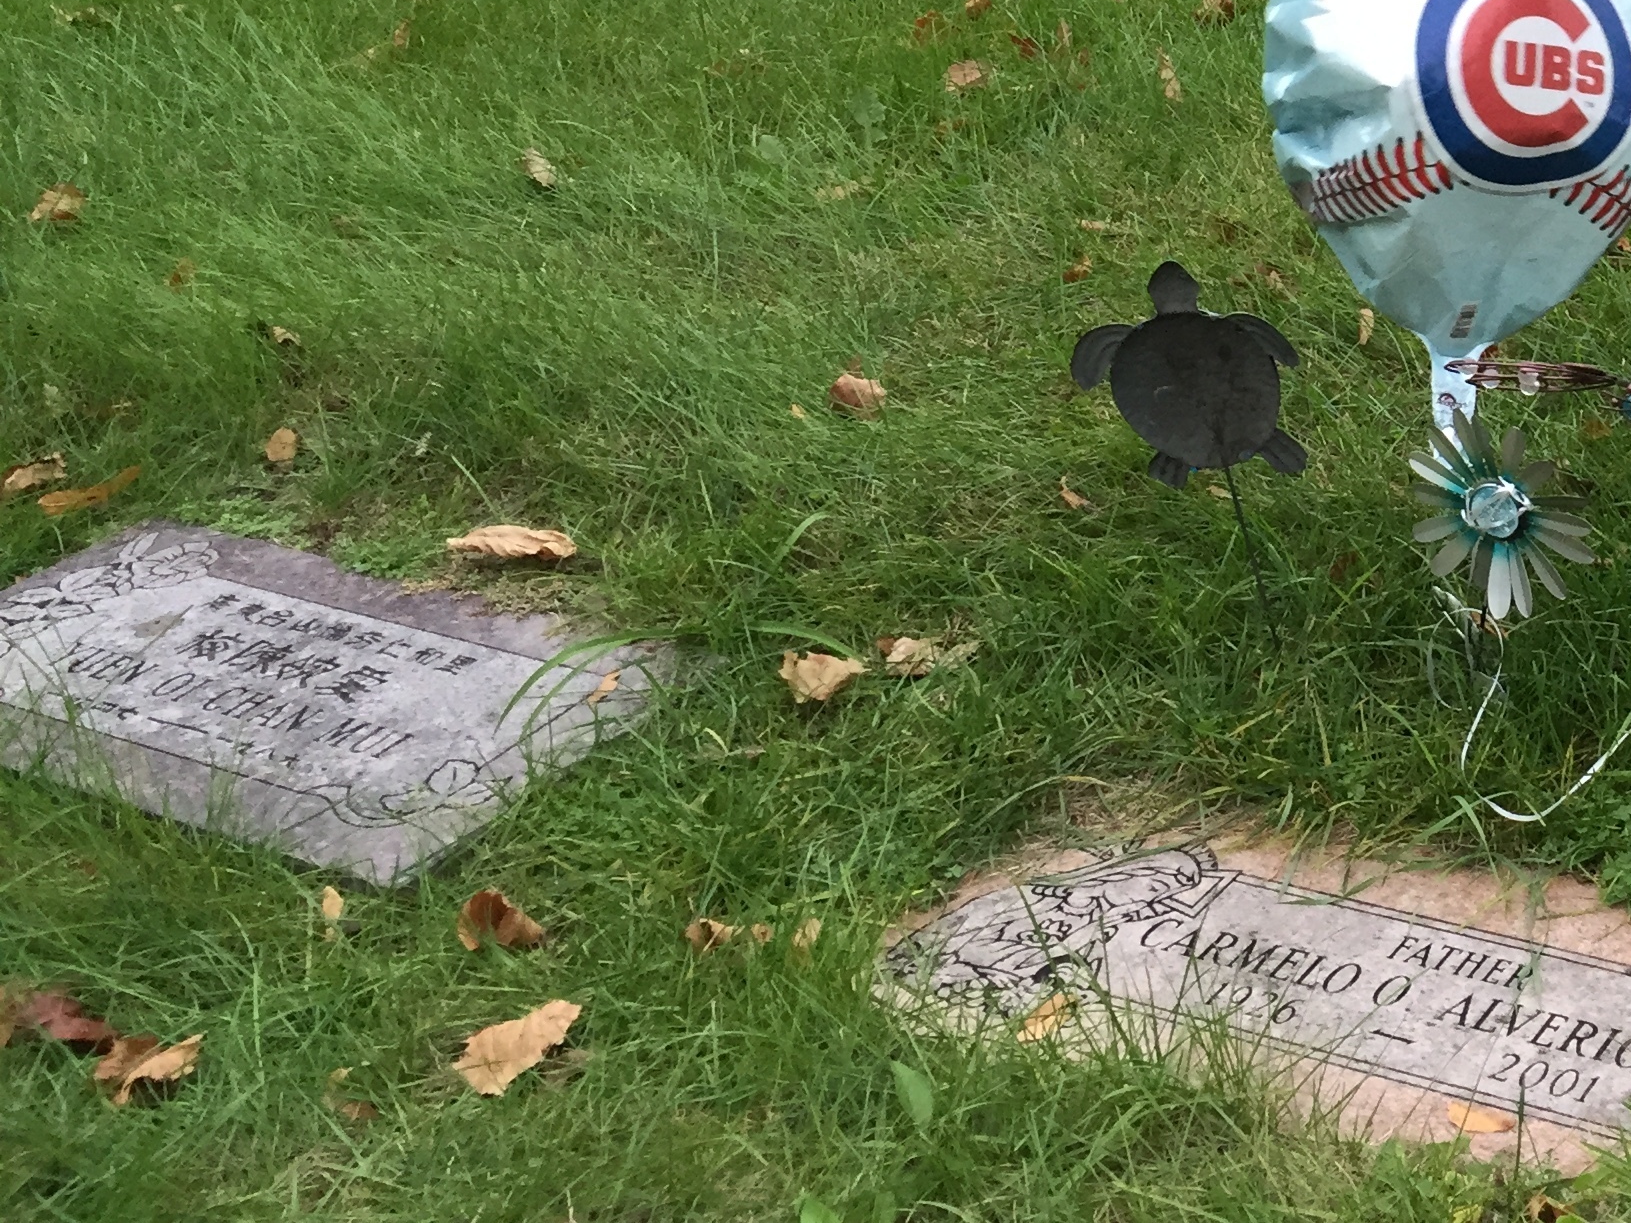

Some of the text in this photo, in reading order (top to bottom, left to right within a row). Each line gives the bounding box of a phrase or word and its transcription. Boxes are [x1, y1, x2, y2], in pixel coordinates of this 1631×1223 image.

[50, 642, 415, 759] YUEN OI CHAN MUI
[1140, 918, 1362, 995] CARMELO
[1386, 935, 1534, 991] FATHER
[1489, 1052, 1601, 1103] 2001
